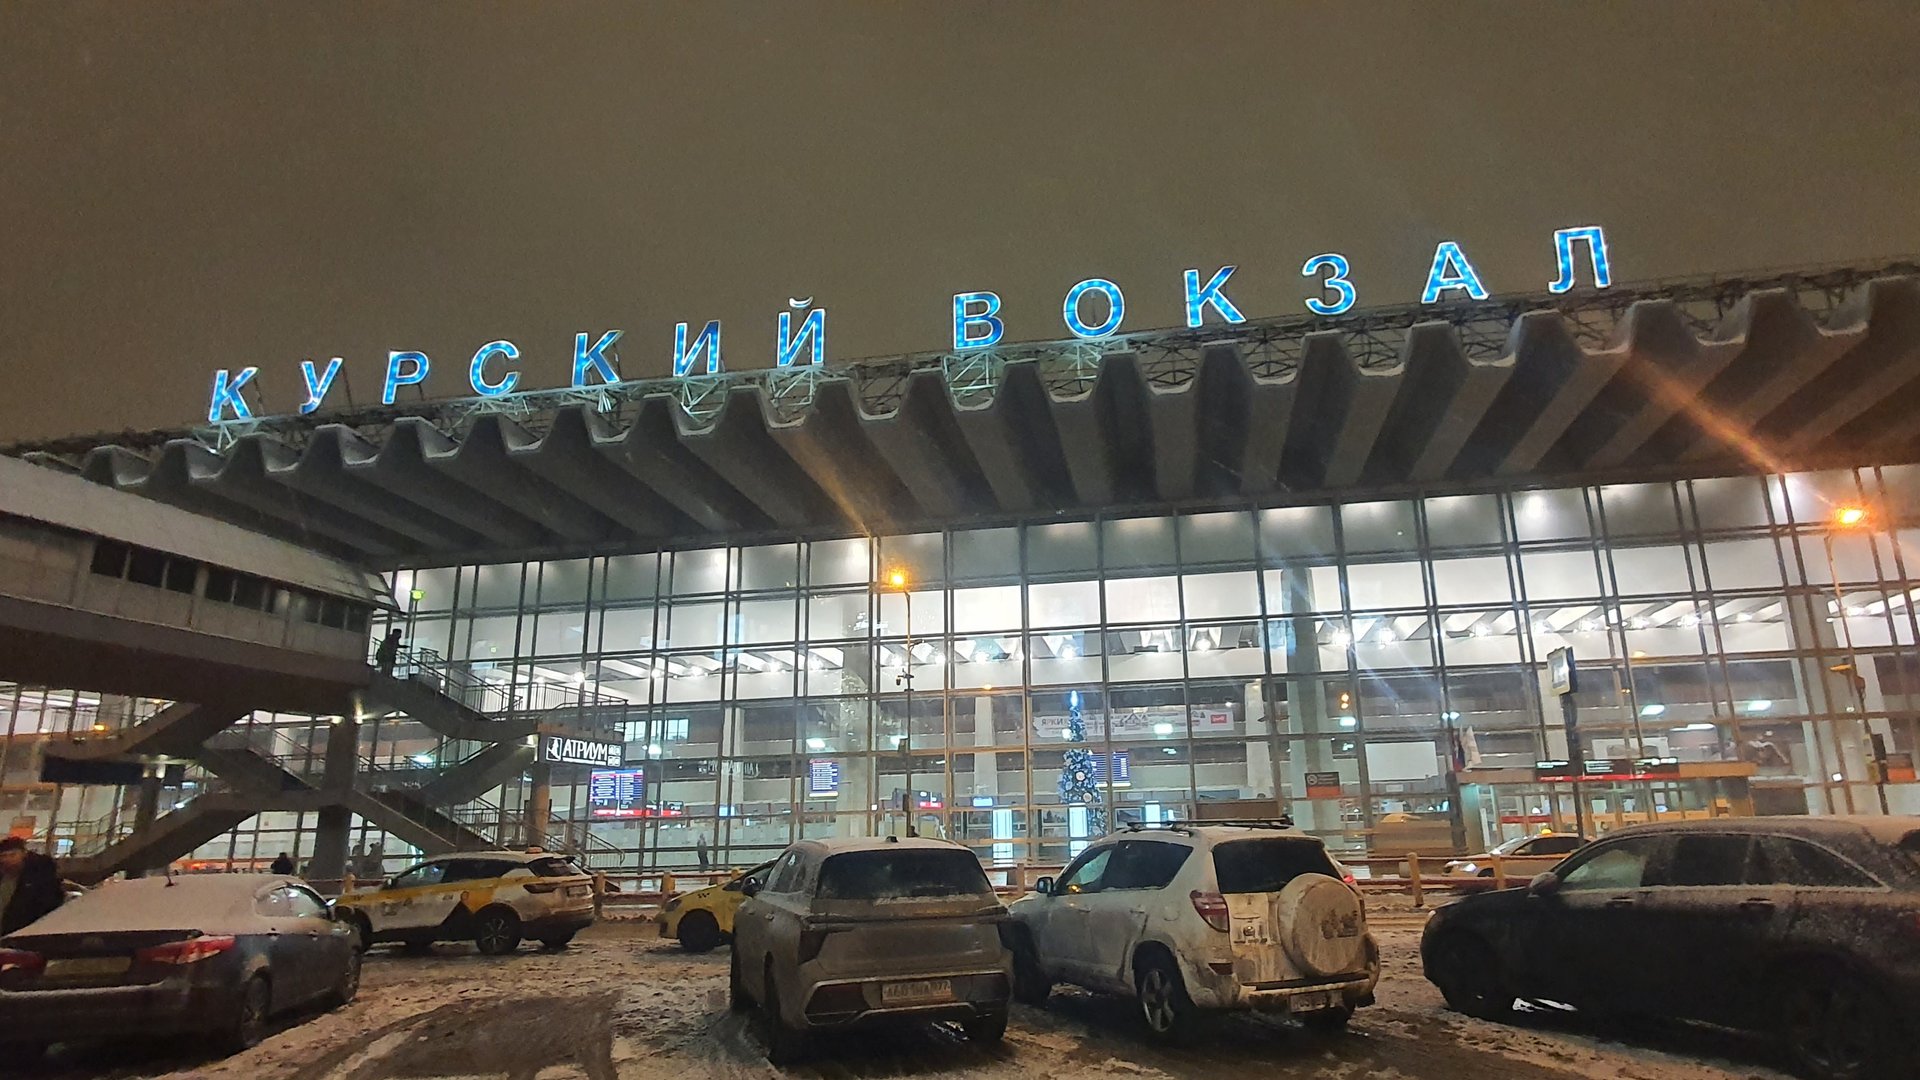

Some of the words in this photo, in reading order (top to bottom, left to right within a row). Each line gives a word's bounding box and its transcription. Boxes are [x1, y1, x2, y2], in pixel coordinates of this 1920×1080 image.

[207, 296, 827, 425] КУРСКИЙ
[952, 225, 1612, 351] ВОКЗАЛ
[562, 738, 608, 761] АТРИУМ
